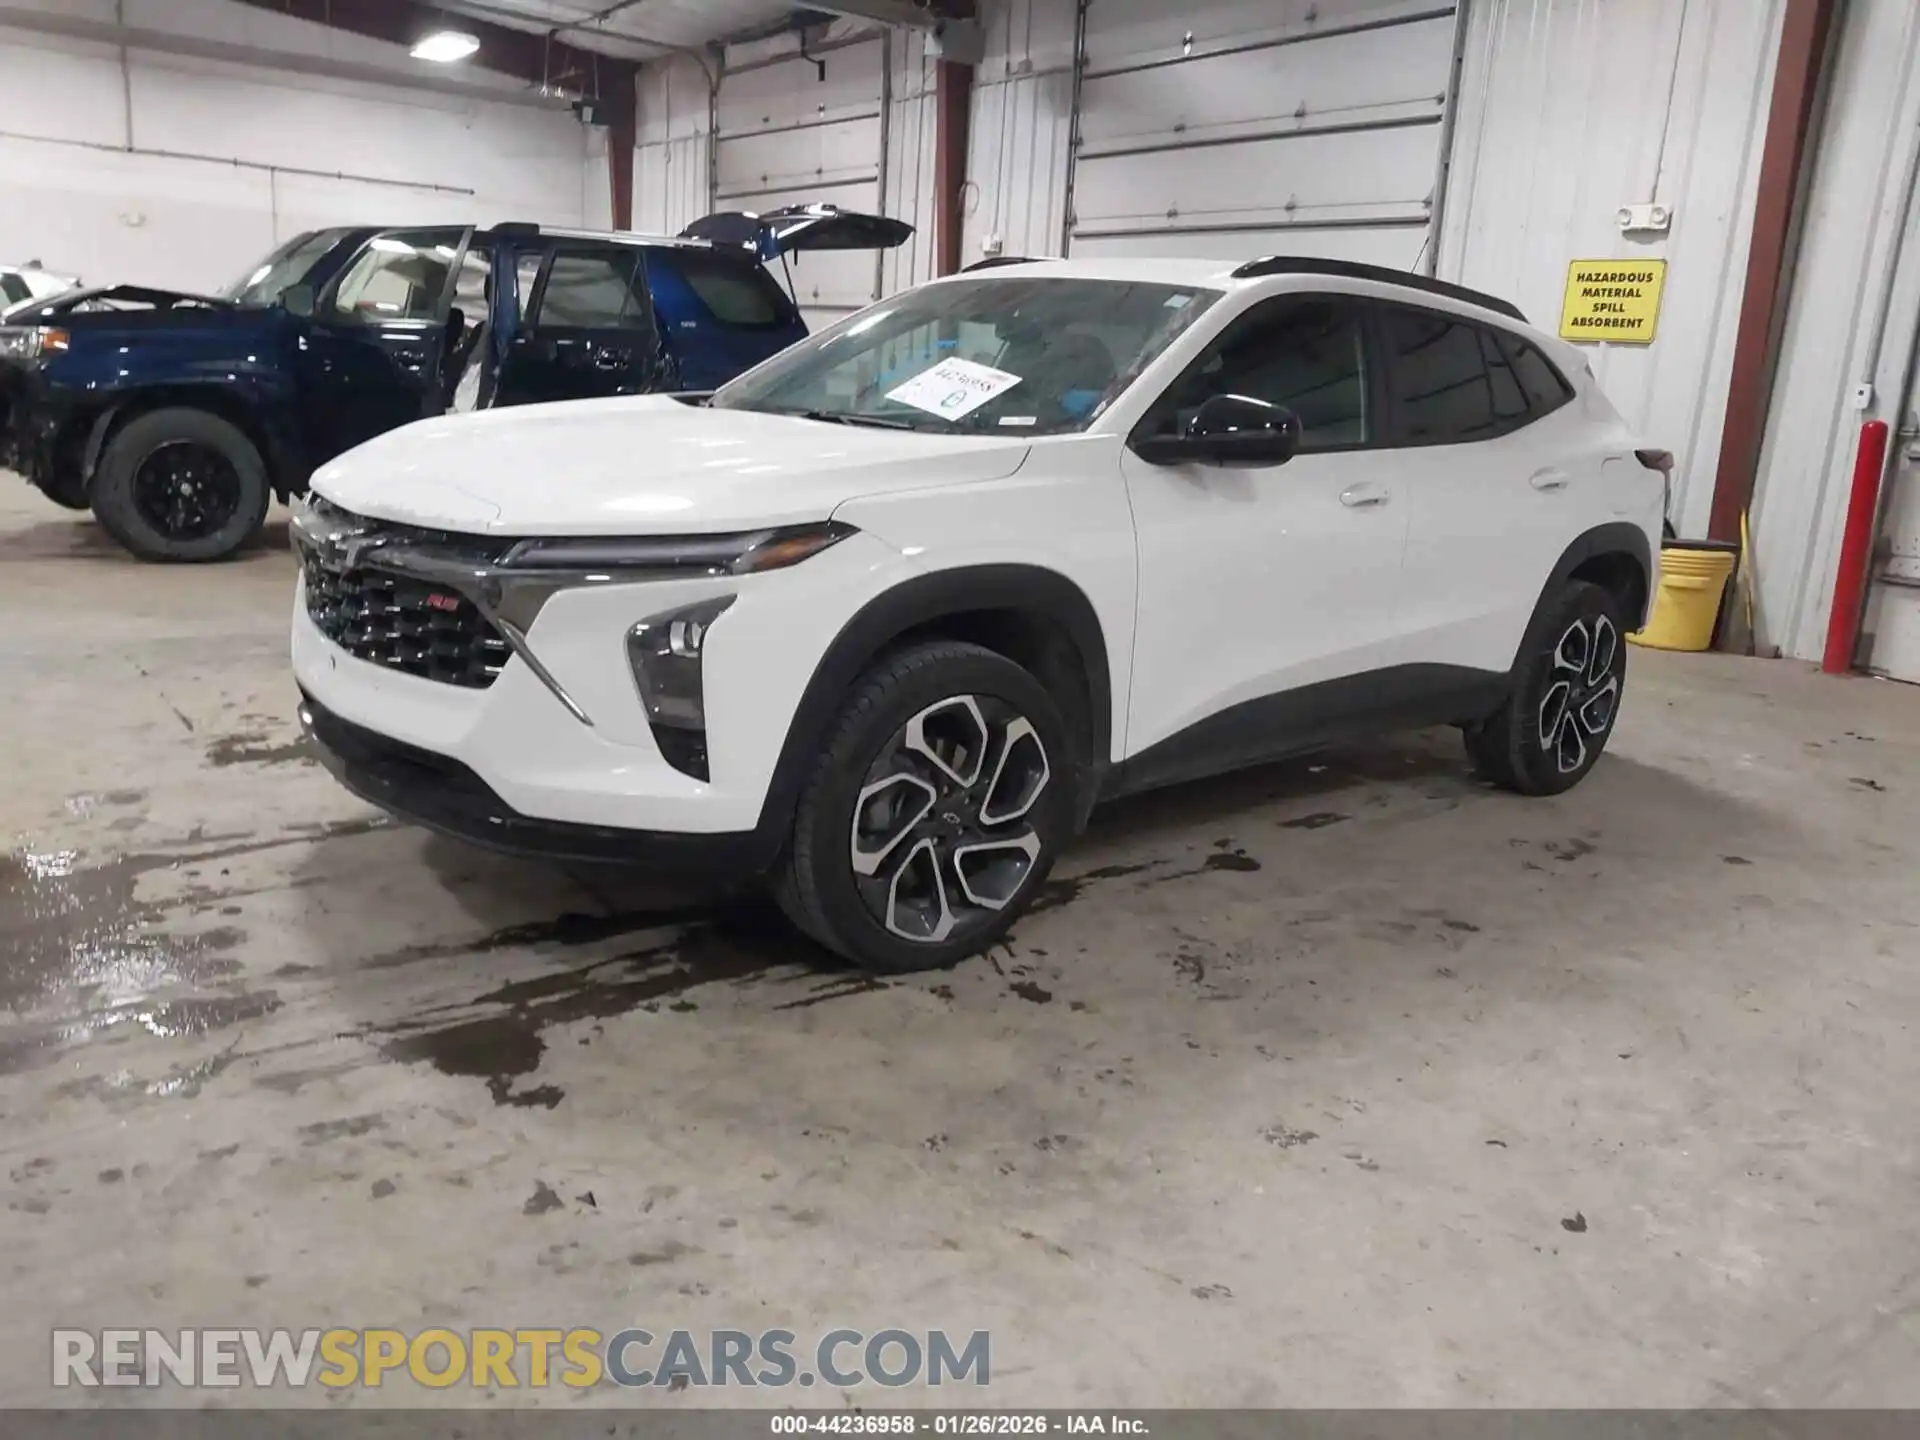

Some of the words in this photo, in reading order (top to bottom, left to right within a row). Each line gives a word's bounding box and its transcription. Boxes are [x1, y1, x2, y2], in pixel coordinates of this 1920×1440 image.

[1576, 272, 1654, 283] HAZARDOUS
[1581, 287, 1642, 298] MATERIAL
[1592, 303, 1625, 313] SPILL
[1571, 317, 1644, 328] ABSORBENT
